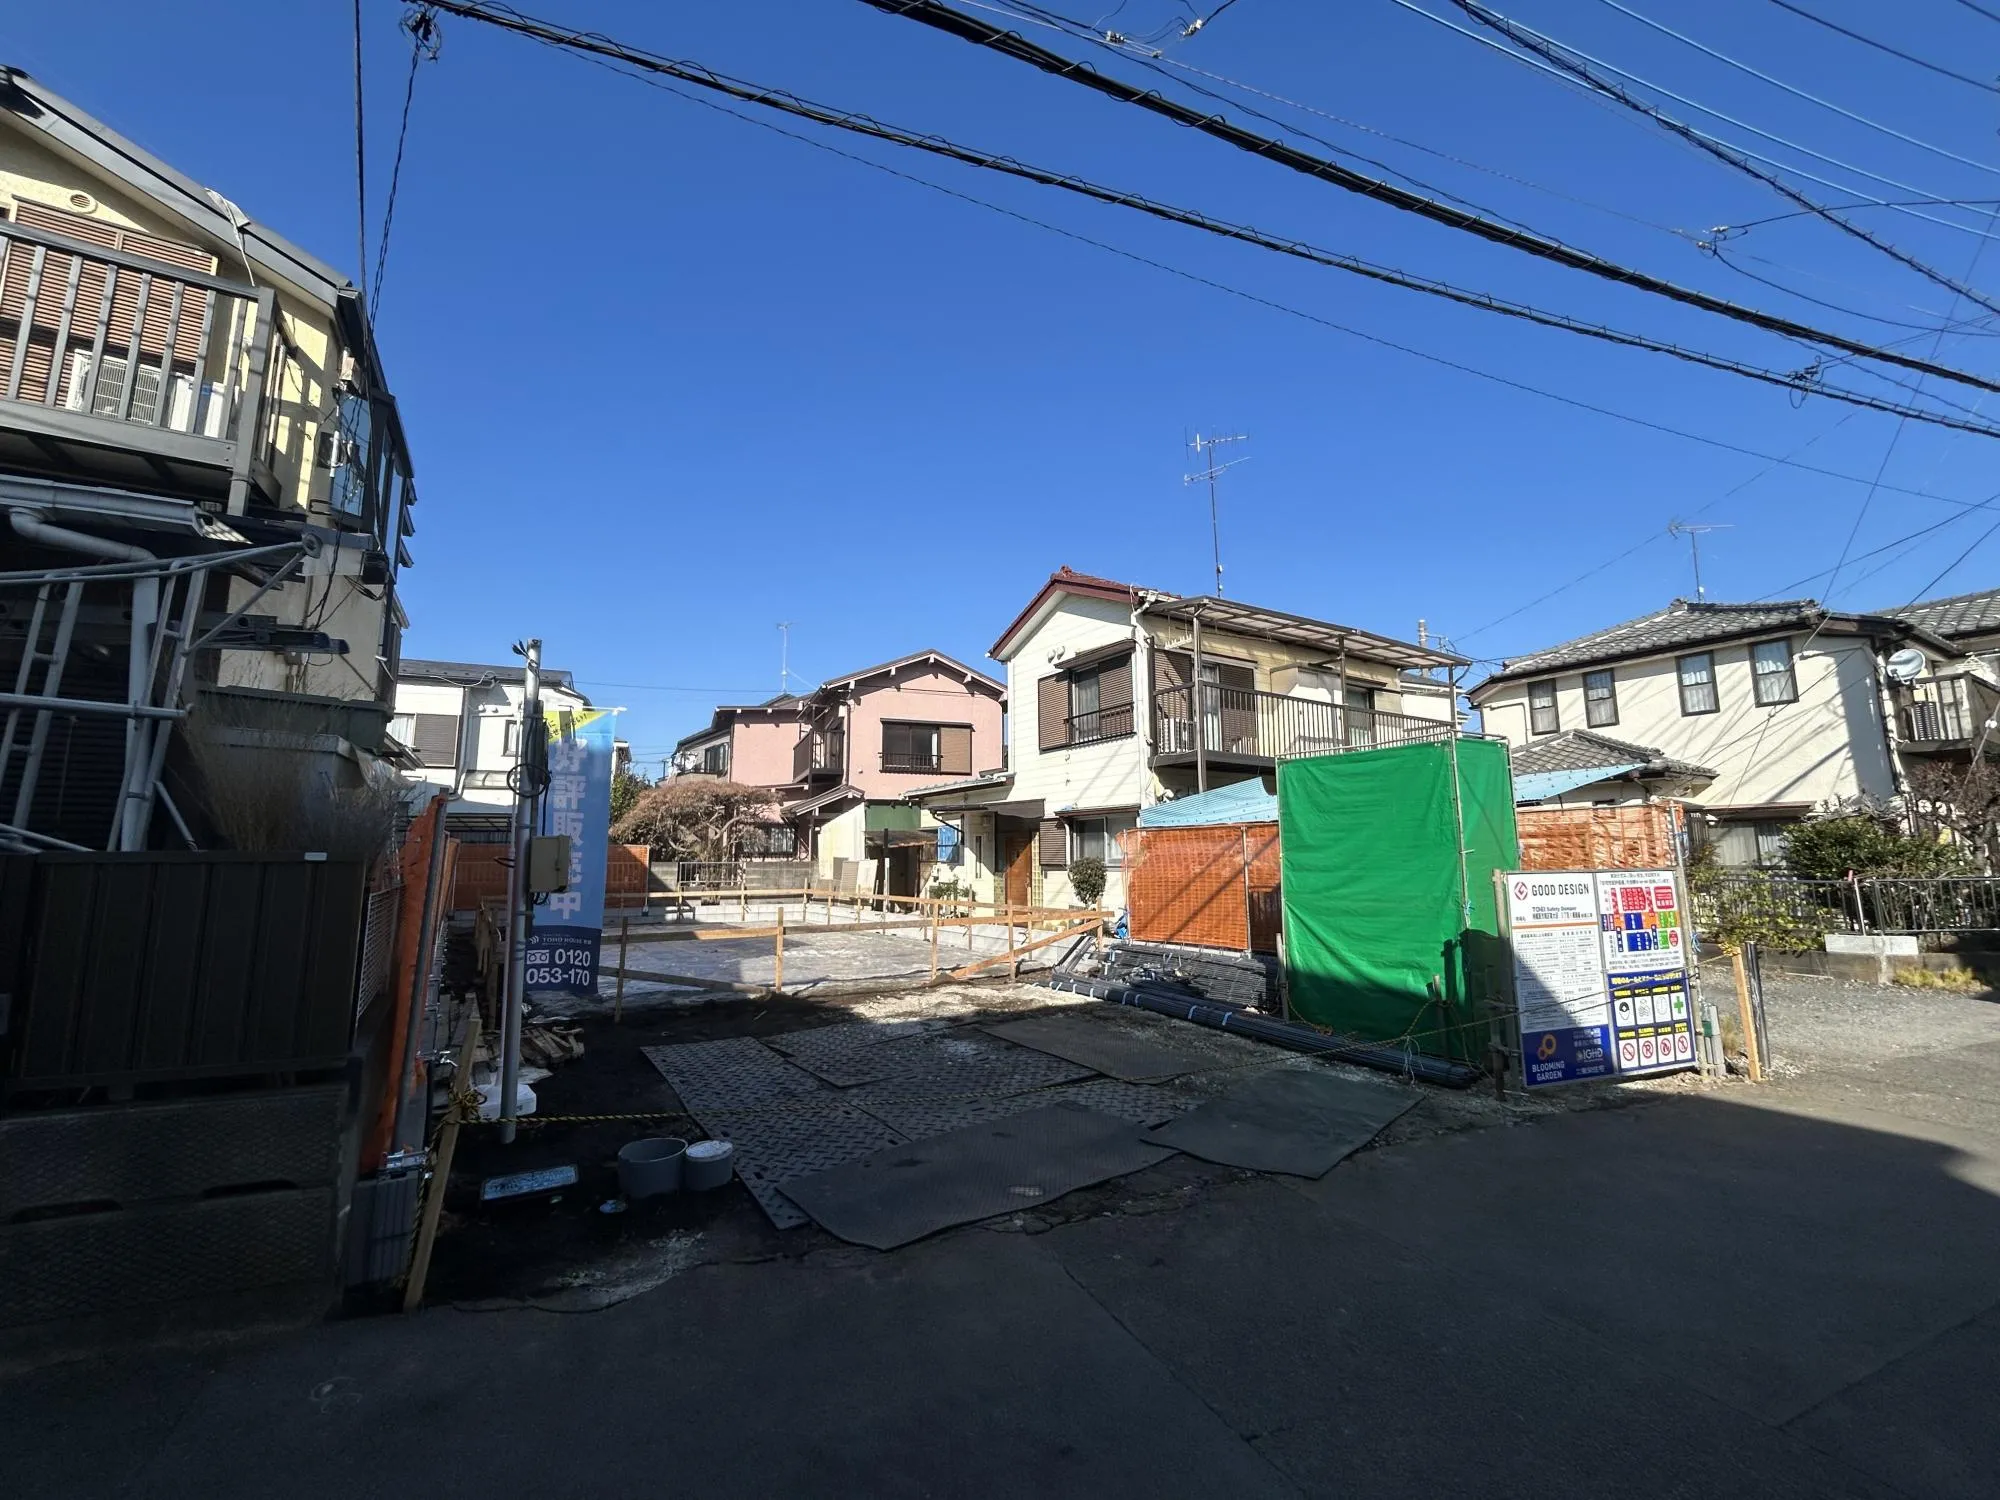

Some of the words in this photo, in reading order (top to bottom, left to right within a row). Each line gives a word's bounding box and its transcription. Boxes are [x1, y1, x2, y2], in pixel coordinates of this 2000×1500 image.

[1532, 884, 1556, 896] GOOD
[1558, 883, 1590, 895] DESIGN
[555, 948, 591, 967] 0120
[526, 967, 590, 986] 053-170
[1532, 1060, 1565, 1073] BLOOMING
[1536, 1070, 1563, 1081] GARDEN
